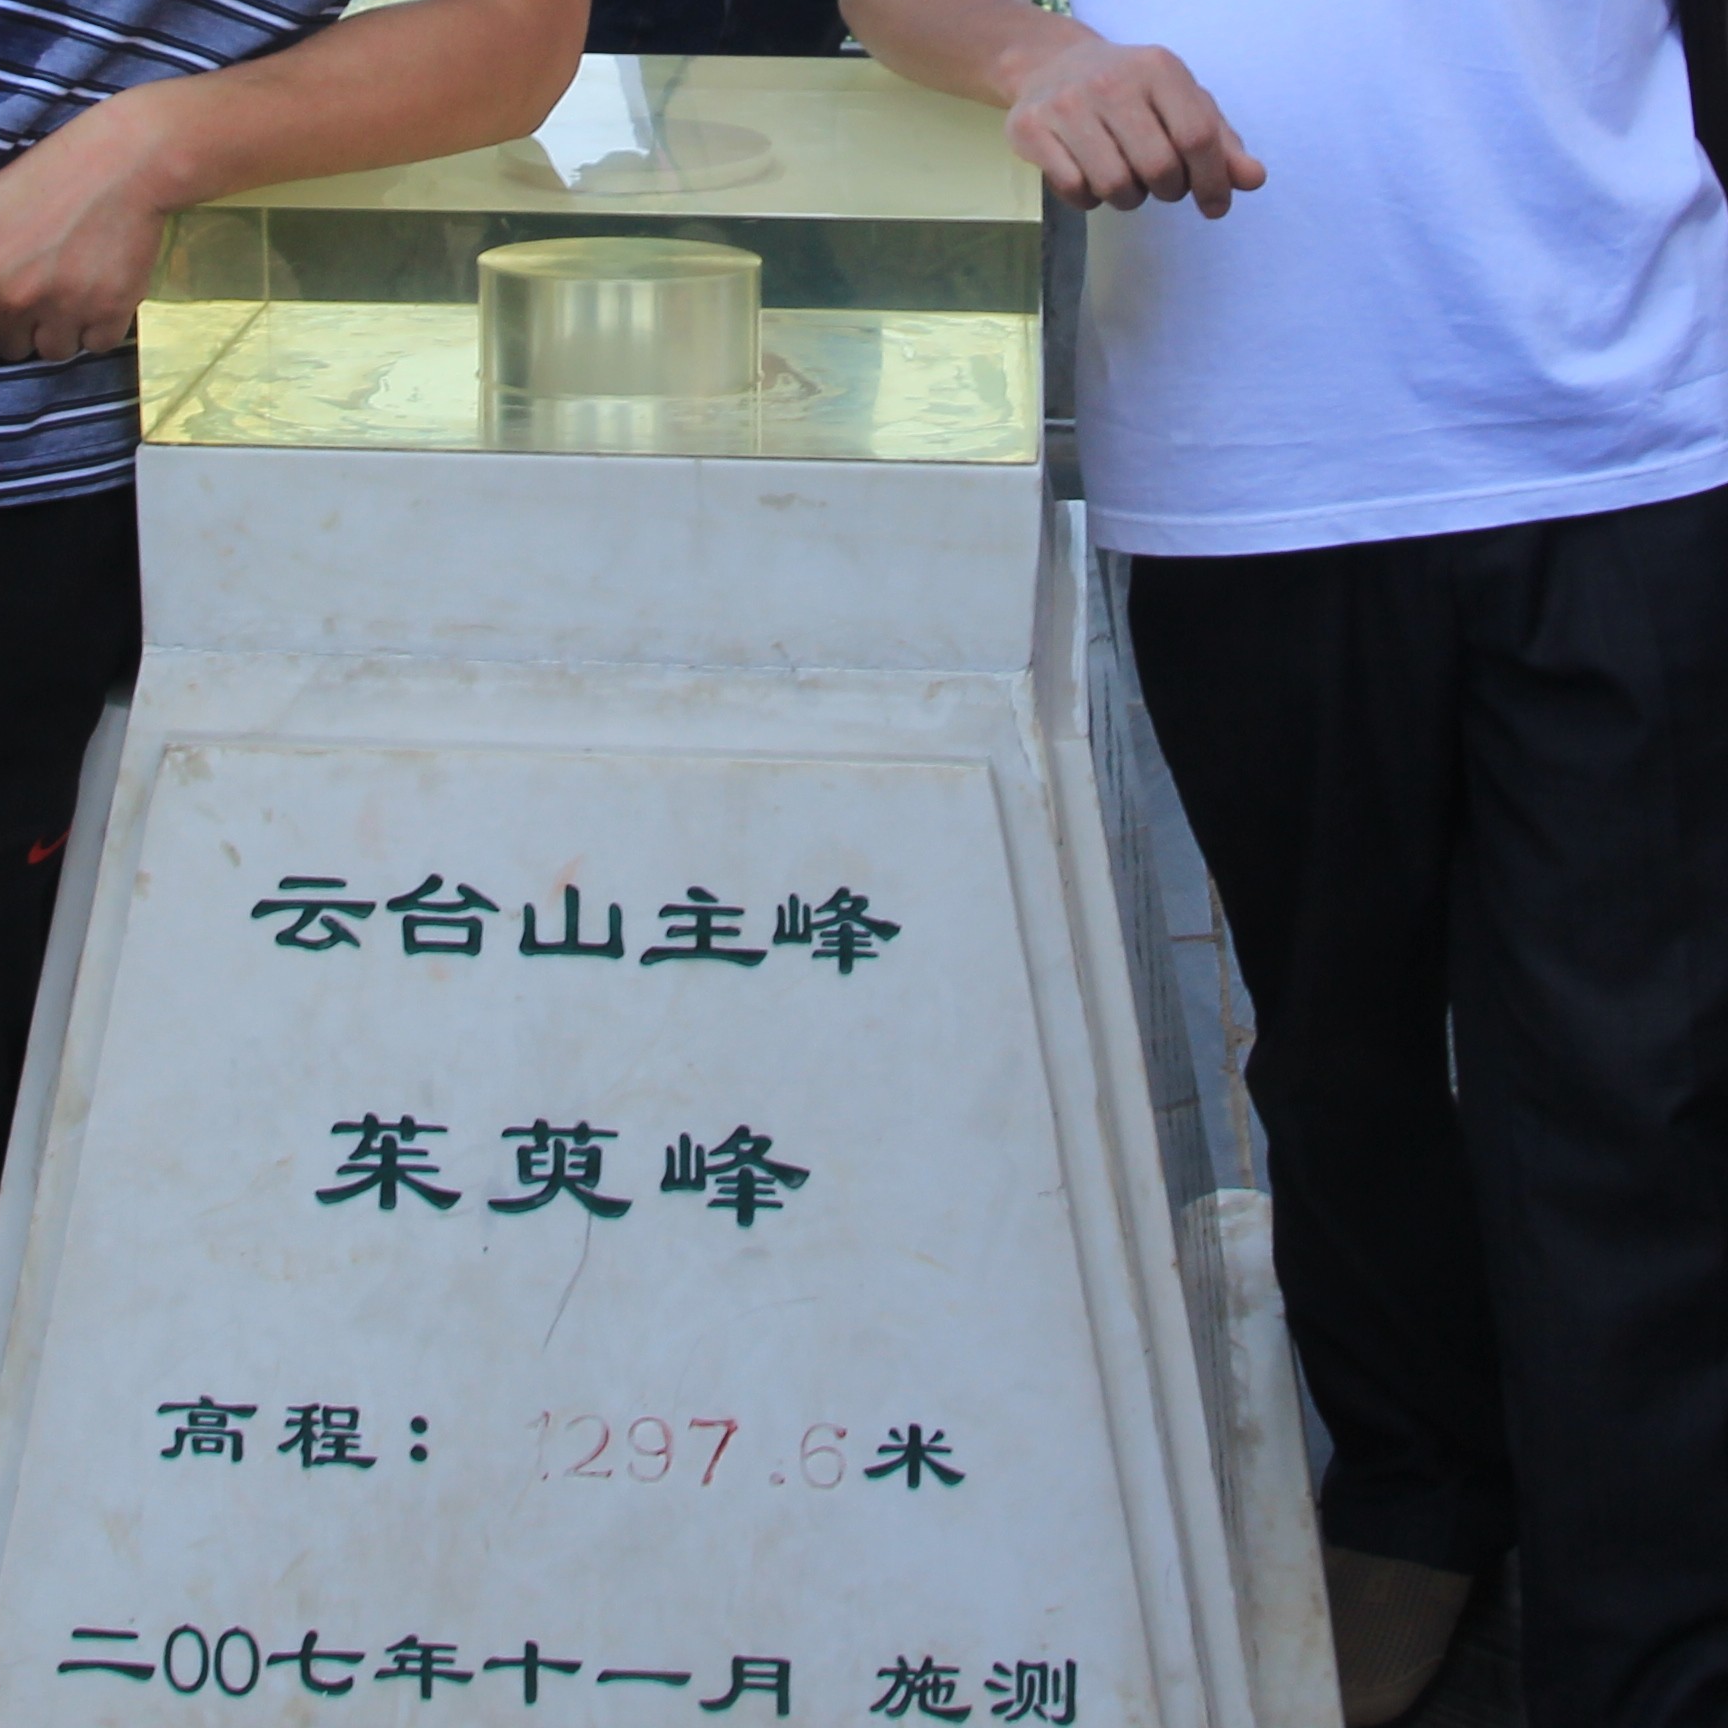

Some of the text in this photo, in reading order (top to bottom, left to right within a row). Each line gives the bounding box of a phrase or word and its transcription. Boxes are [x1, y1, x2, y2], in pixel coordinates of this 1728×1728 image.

[251, 874, 901, 975] 云台山主峰
[315, 1113, 810, 1228] 茱萸峰
[869, 1655, 1078, 1728] 施测
